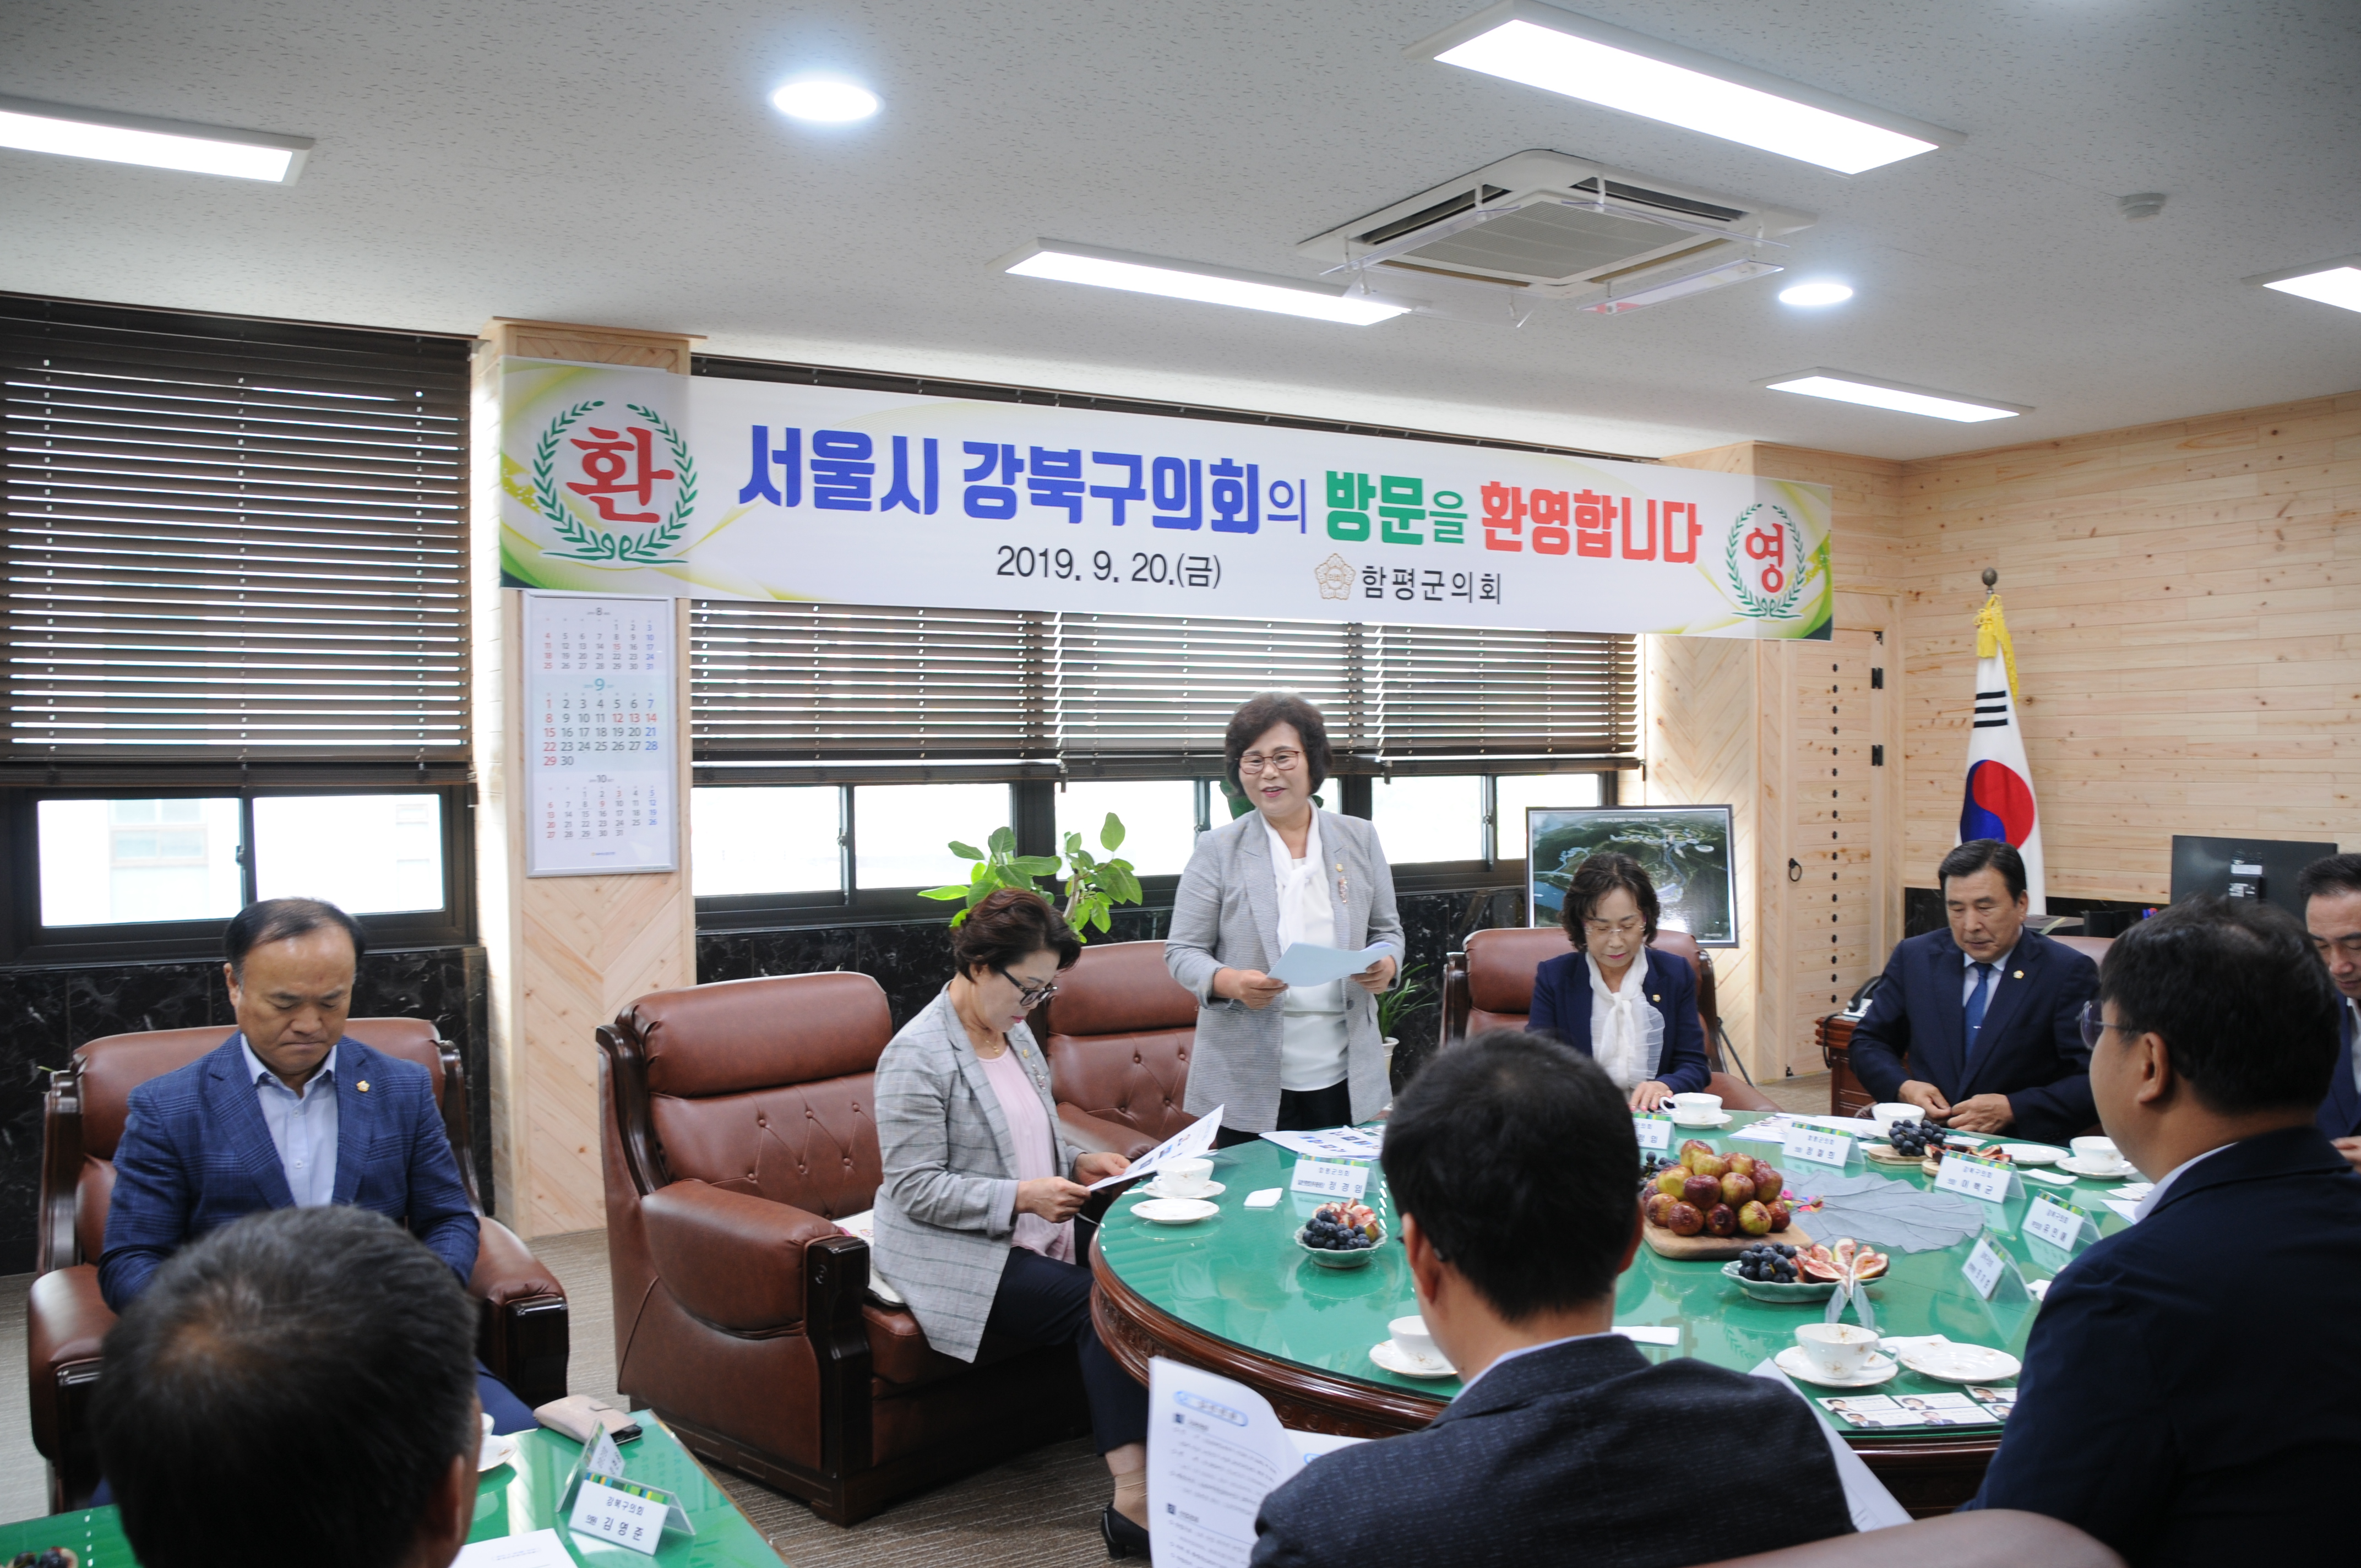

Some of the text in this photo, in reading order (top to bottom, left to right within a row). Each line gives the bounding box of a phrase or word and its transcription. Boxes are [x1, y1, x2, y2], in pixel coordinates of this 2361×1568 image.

[566, 424, 675, 525] 환
[738, 423, 1703, 565] 서울시 강북구의회의 방문을 환영합니다
[1743, 521, 1785, 594] 영
[996, 545, 1222, 590] 2019. 9. 20.(금)
[1362, 565, 1502, 606] 함평군의회
[596, 607, 602, 616] 8
[594, 678, 605, 692] 9
[546, 699, 654, 709] 1 2 3 4 5 6 7
[545, 713, 657, 723] 8 9 10 11 12 13 14
[544, 727, 656, 738] 15 16 17 18 19 20 21
[543, 741, 658, 752] 22 23 24 25 26 27 28
[543, 755, 574, 766] 29 30
[596, 775, 607, 783] 10
